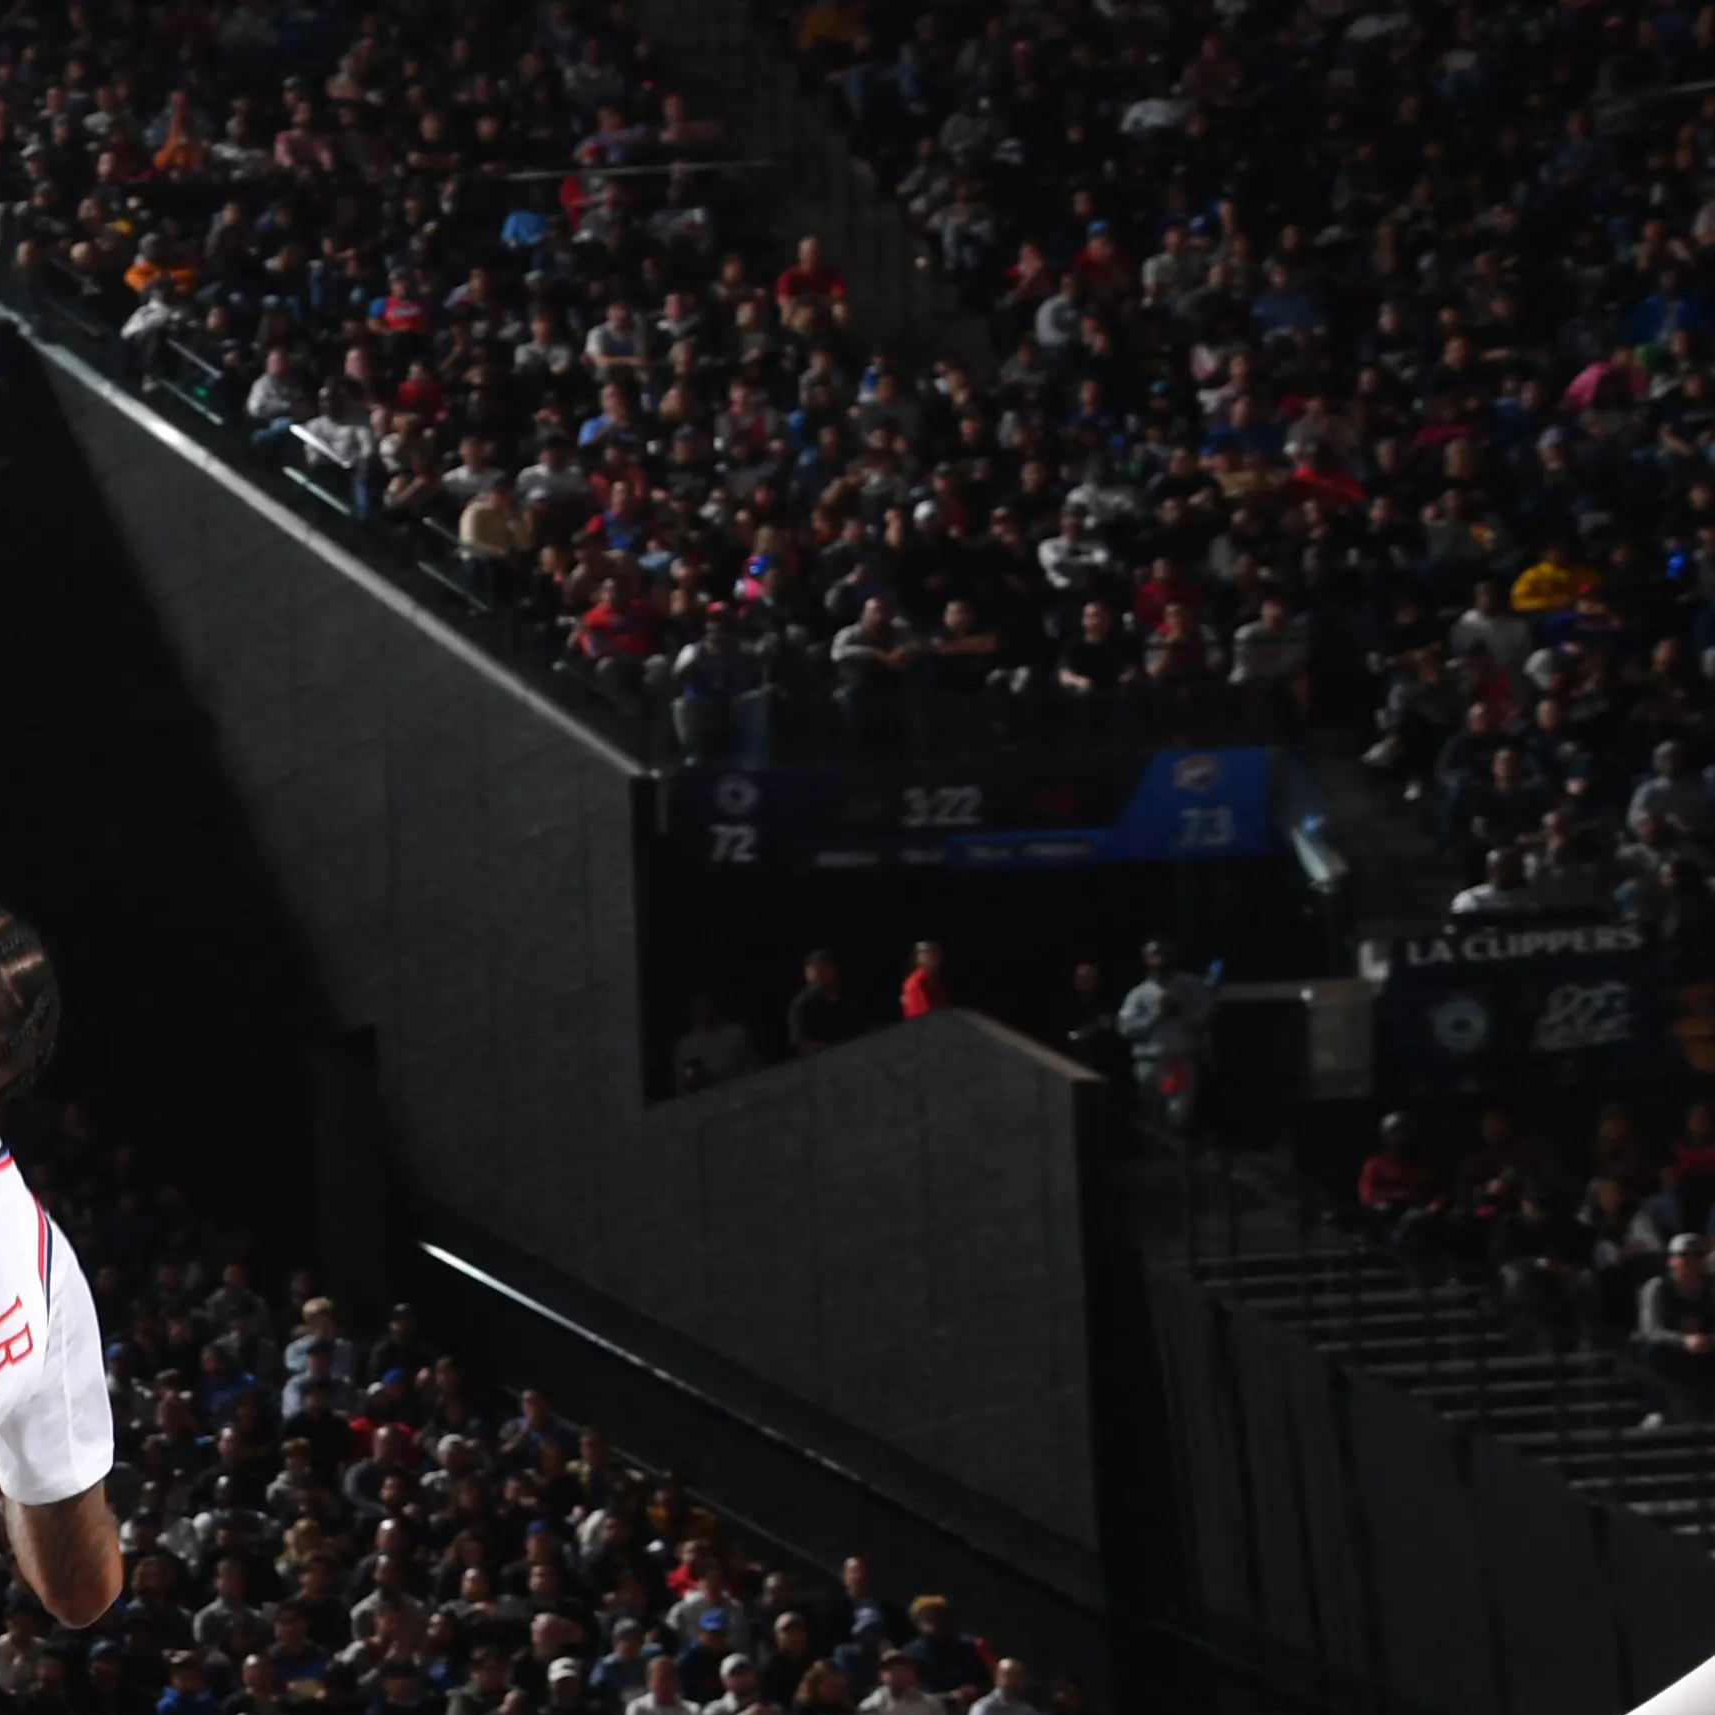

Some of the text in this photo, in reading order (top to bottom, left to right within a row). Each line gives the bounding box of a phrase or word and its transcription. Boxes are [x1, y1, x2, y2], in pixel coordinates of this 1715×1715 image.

[710, 823, 758, 862] 72
[1406, 925, 1645, 966] LA CLIPPERS
